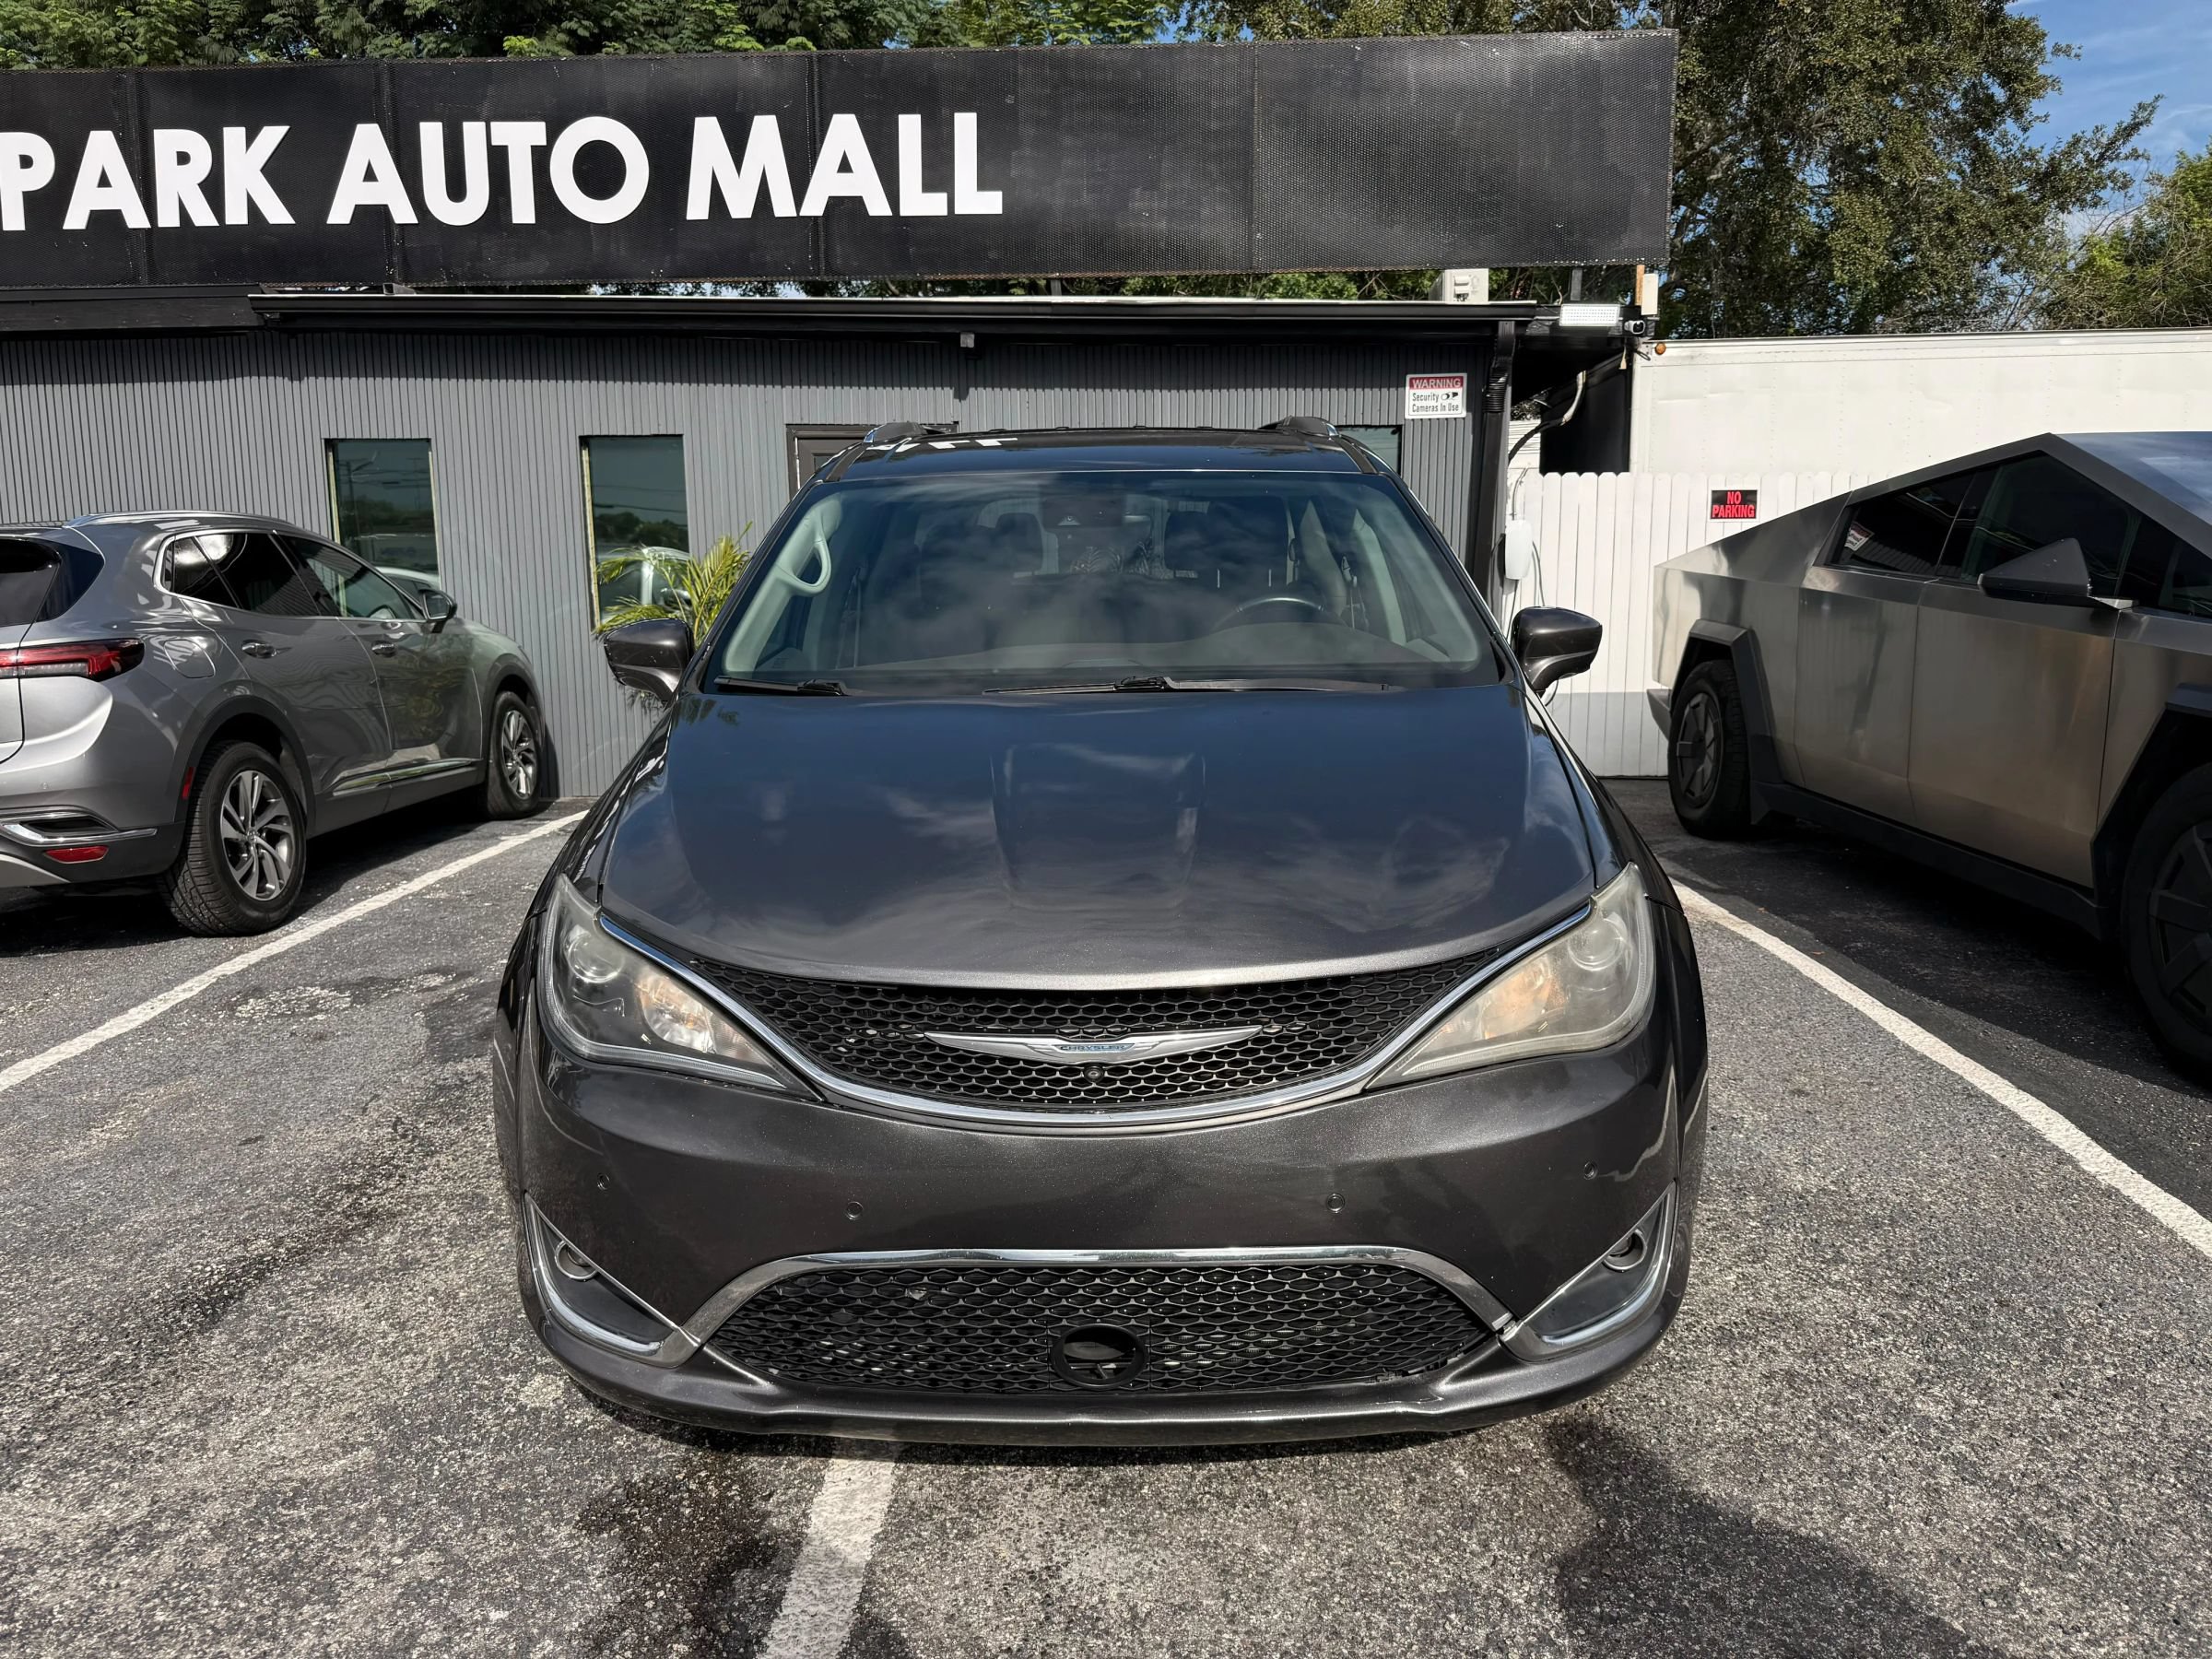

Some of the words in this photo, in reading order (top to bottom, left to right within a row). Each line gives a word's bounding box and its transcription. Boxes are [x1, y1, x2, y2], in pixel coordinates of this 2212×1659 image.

[0, 125, 295, 230] PARK
[326, 115, 649, 227] AUTO
[686, 112, 1003, 220] MALL
[1412, 378, 1461, 389] WARNING
[1412, 392, 1440, 403] Security
[1412, 405, 1438, 413] Cameras
[1440, 404, 1446, 412] In
[1448, 404, 1459, 412] Use
[1727, 491, 1742, 504] NO
[1712, 504, 1755, 517] PARKING
